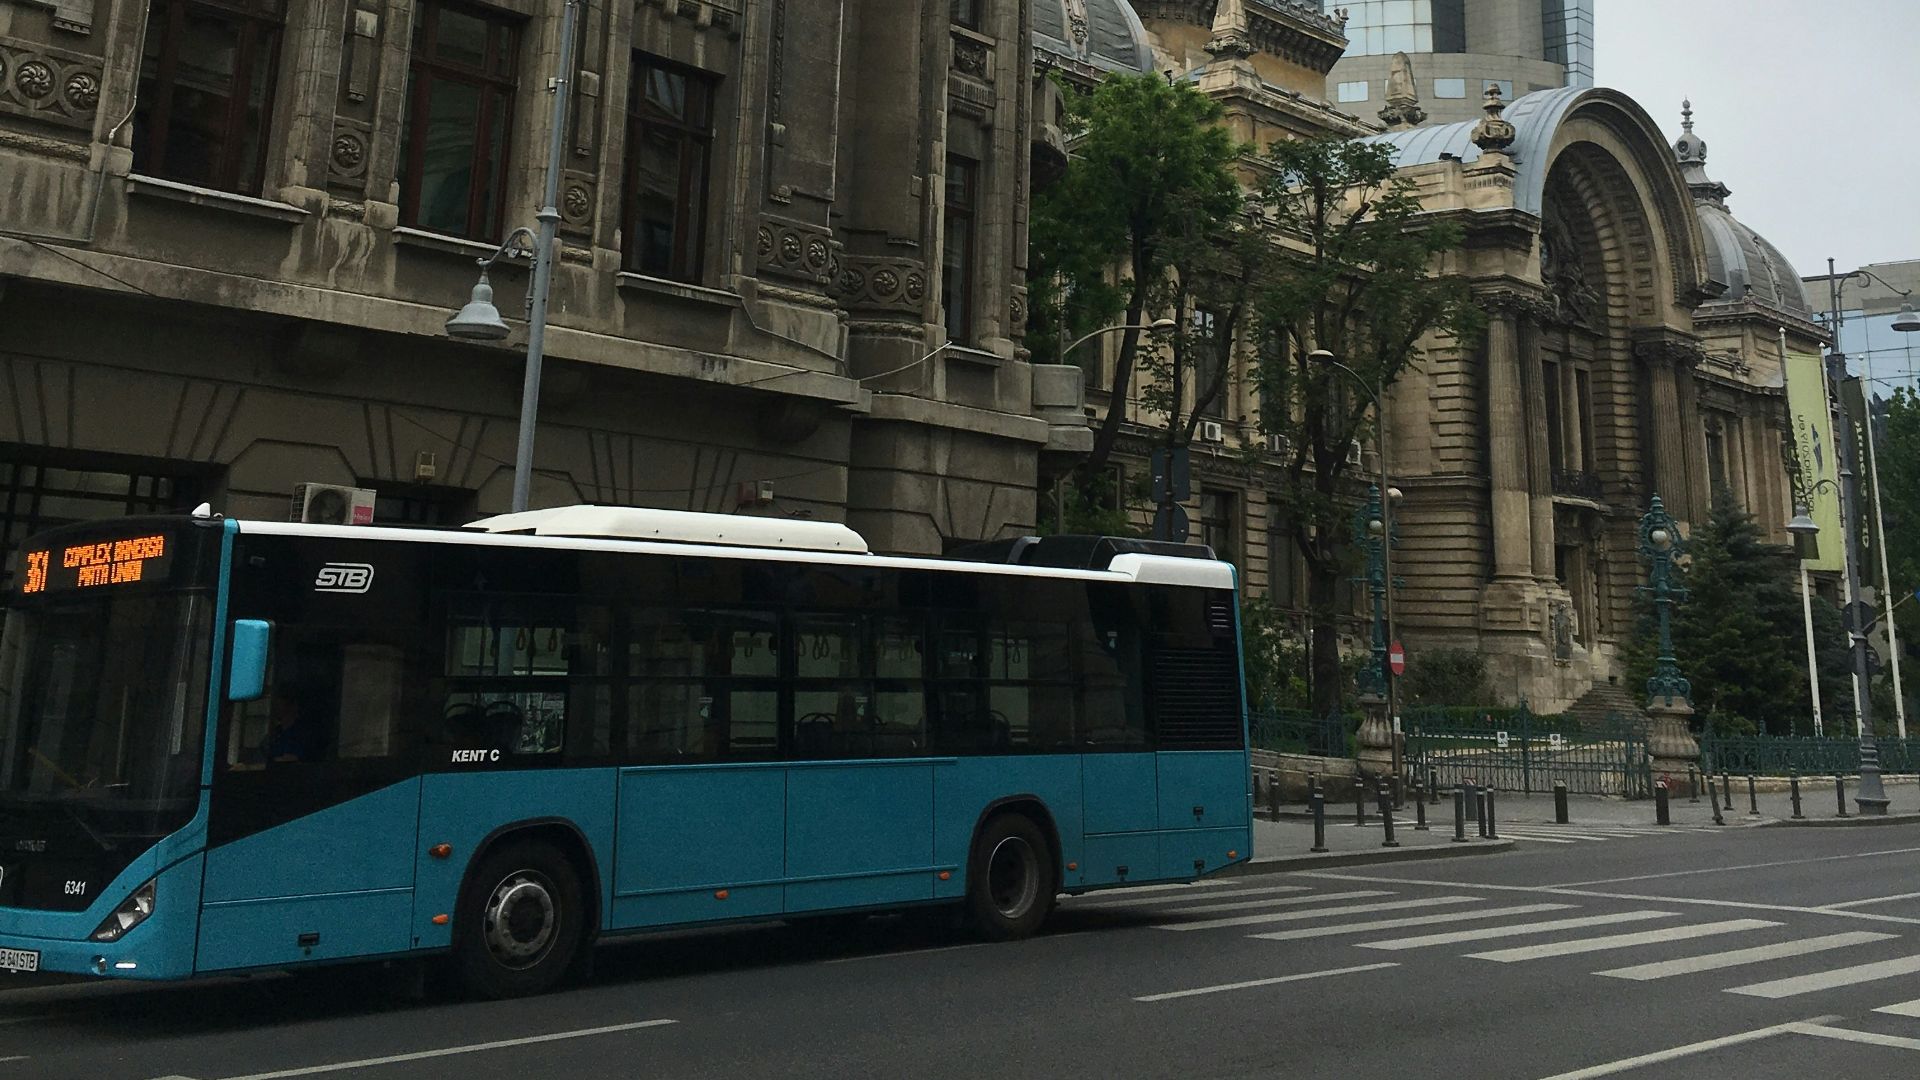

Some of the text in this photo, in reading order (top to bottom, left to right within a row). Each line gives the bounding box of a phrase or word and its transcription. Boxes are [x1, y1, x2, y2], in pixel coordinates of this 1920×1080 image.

[64, 536, 164, 567] COMPLEX BANEASA
[315, 564, 371, 591] STB
[452, 749, 500, 762] KENT C
[64, 880, 86, 895] 6341
